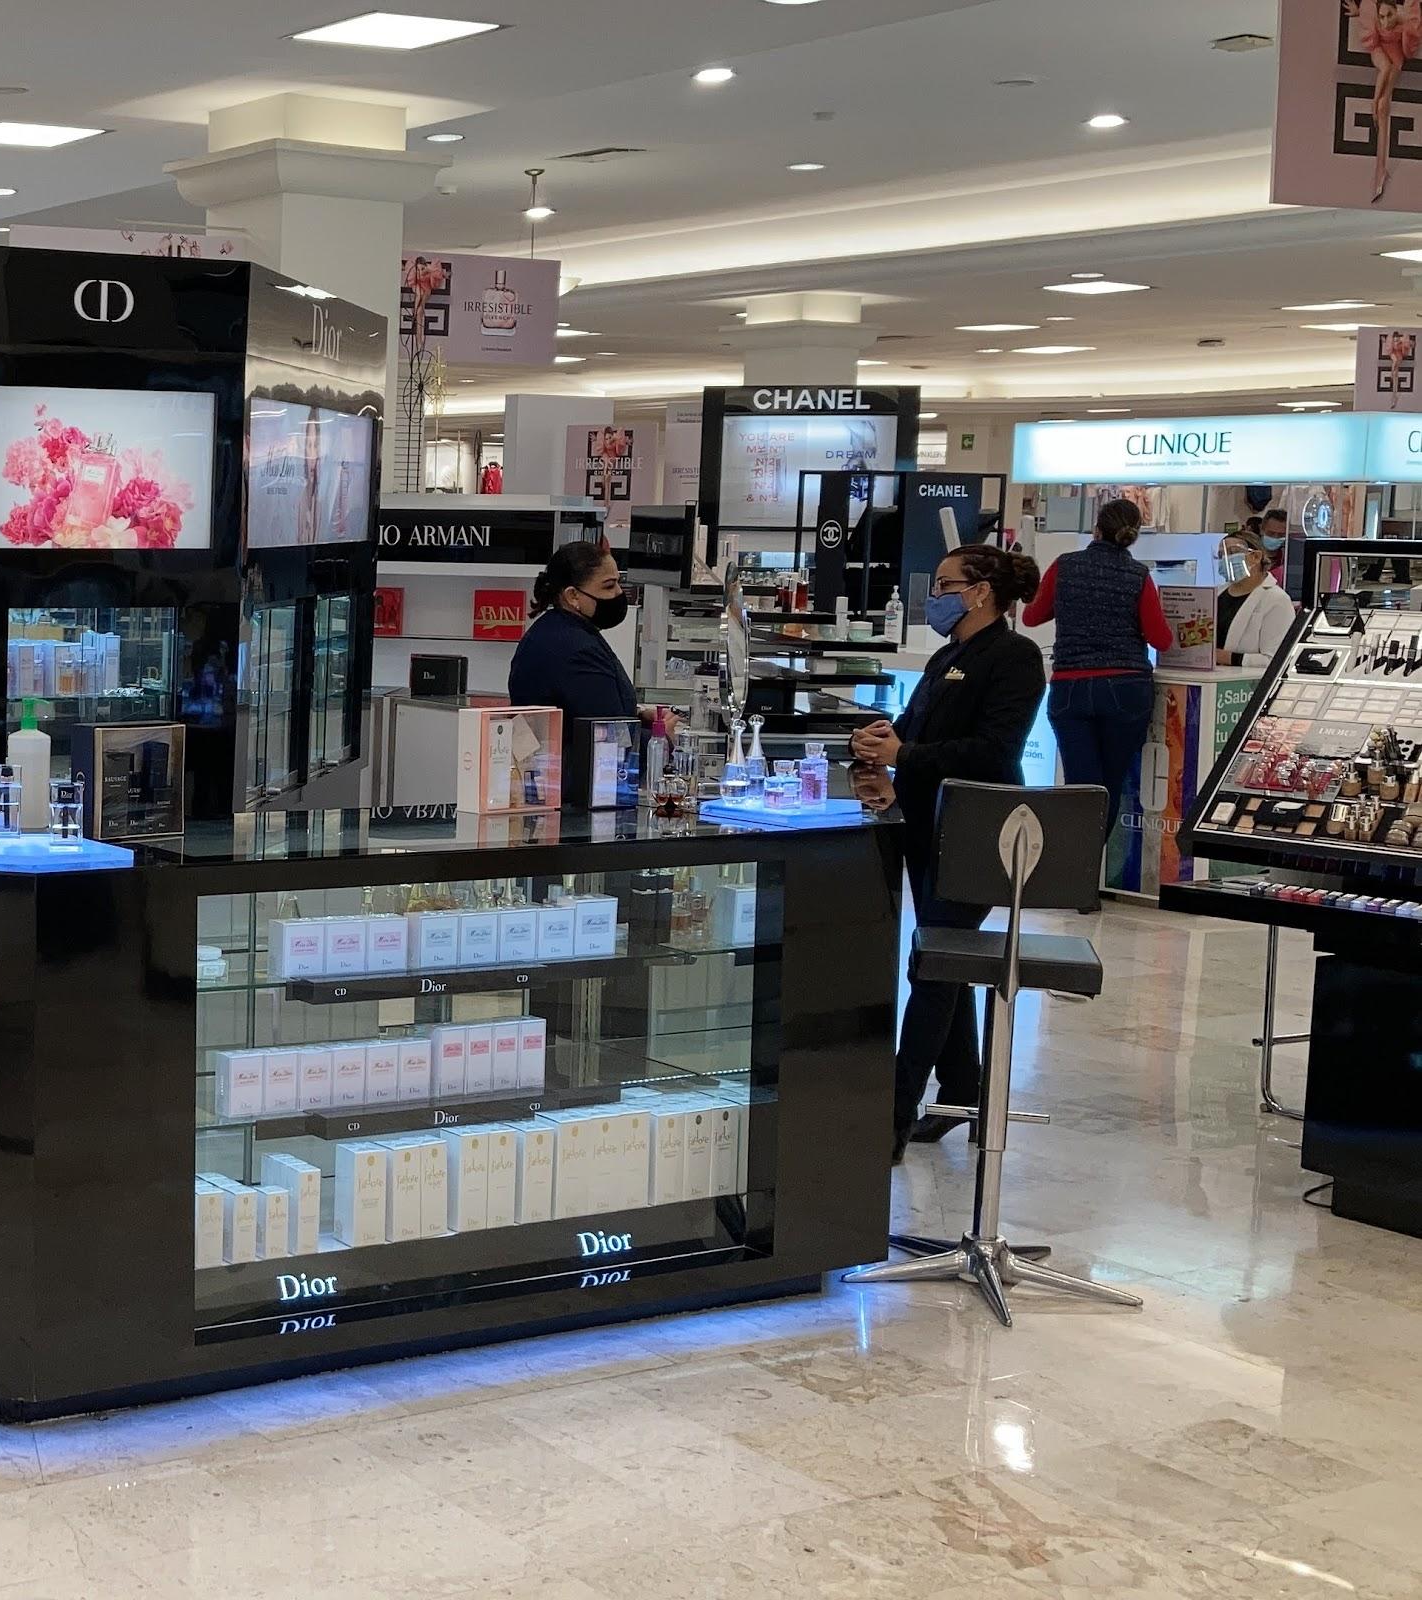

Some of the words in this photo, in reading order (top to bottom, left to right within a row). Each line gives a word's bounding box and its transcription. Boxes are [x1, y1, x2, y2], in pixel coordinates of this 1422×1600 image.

[463, 301, 533, 315] IRRESISTIBLE
[311, 303, 343, 361] Dior
[753, 388, 871, 410] CHANEL
[1126, 431, 1232, 457] CLINIQUE
[1408, 430, 1422, 453] C
[825, 450, 877, 459] DREAM
[918, 483, 969, 498] CHANEL
[408, 525, 491, 547] ARMANI
[334, 988, 347, 997] CD
[420, 979, 447, 993] Dior
[516, 974, 528, 983] CD
[347, 1122, 360, 1131] CD
[434, 1110, 460, 1125] Dior
[529, 1103, 541, 1111] CD
[576, 1230, 632, 1257] Dior
[276, 1272, 338, 1301] Dior
